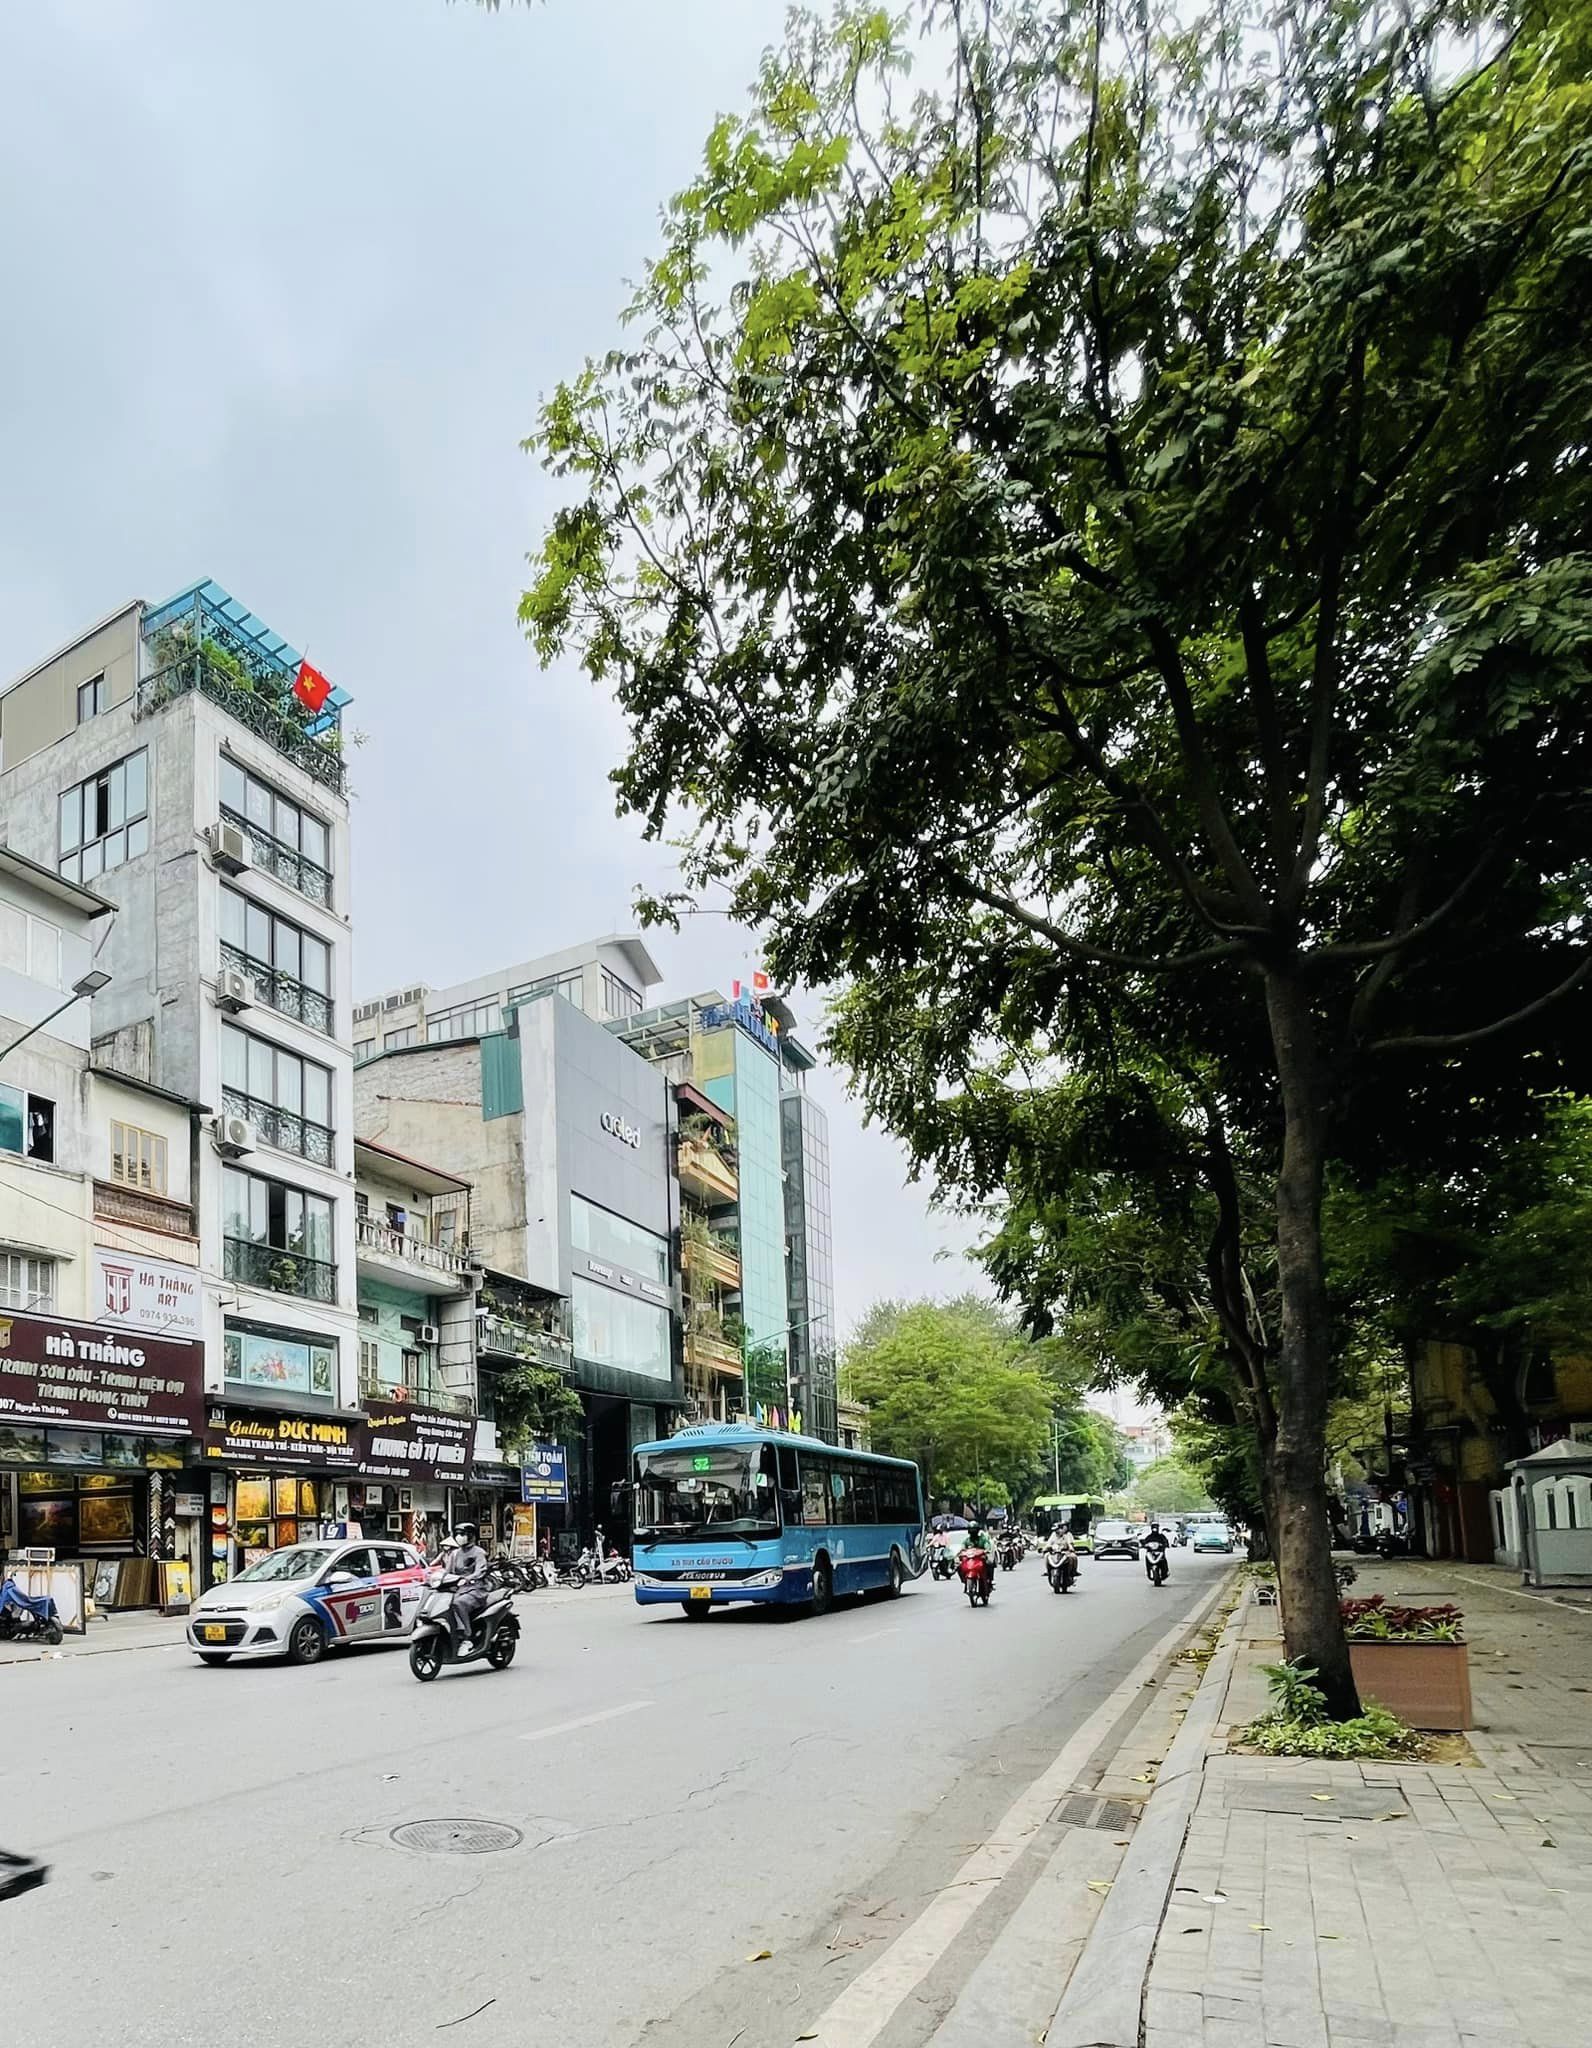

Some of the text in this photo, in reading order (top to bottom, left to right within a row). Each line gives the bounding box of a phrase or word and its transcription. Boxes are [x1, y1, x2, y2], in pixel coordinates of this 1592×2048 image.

[157, 1294, 178, 1308] ART
[46, 1331, 146, 1367] HÀ THẮNG
[229, 1418, 347, 1444] Gallery ĐỨC MINH
